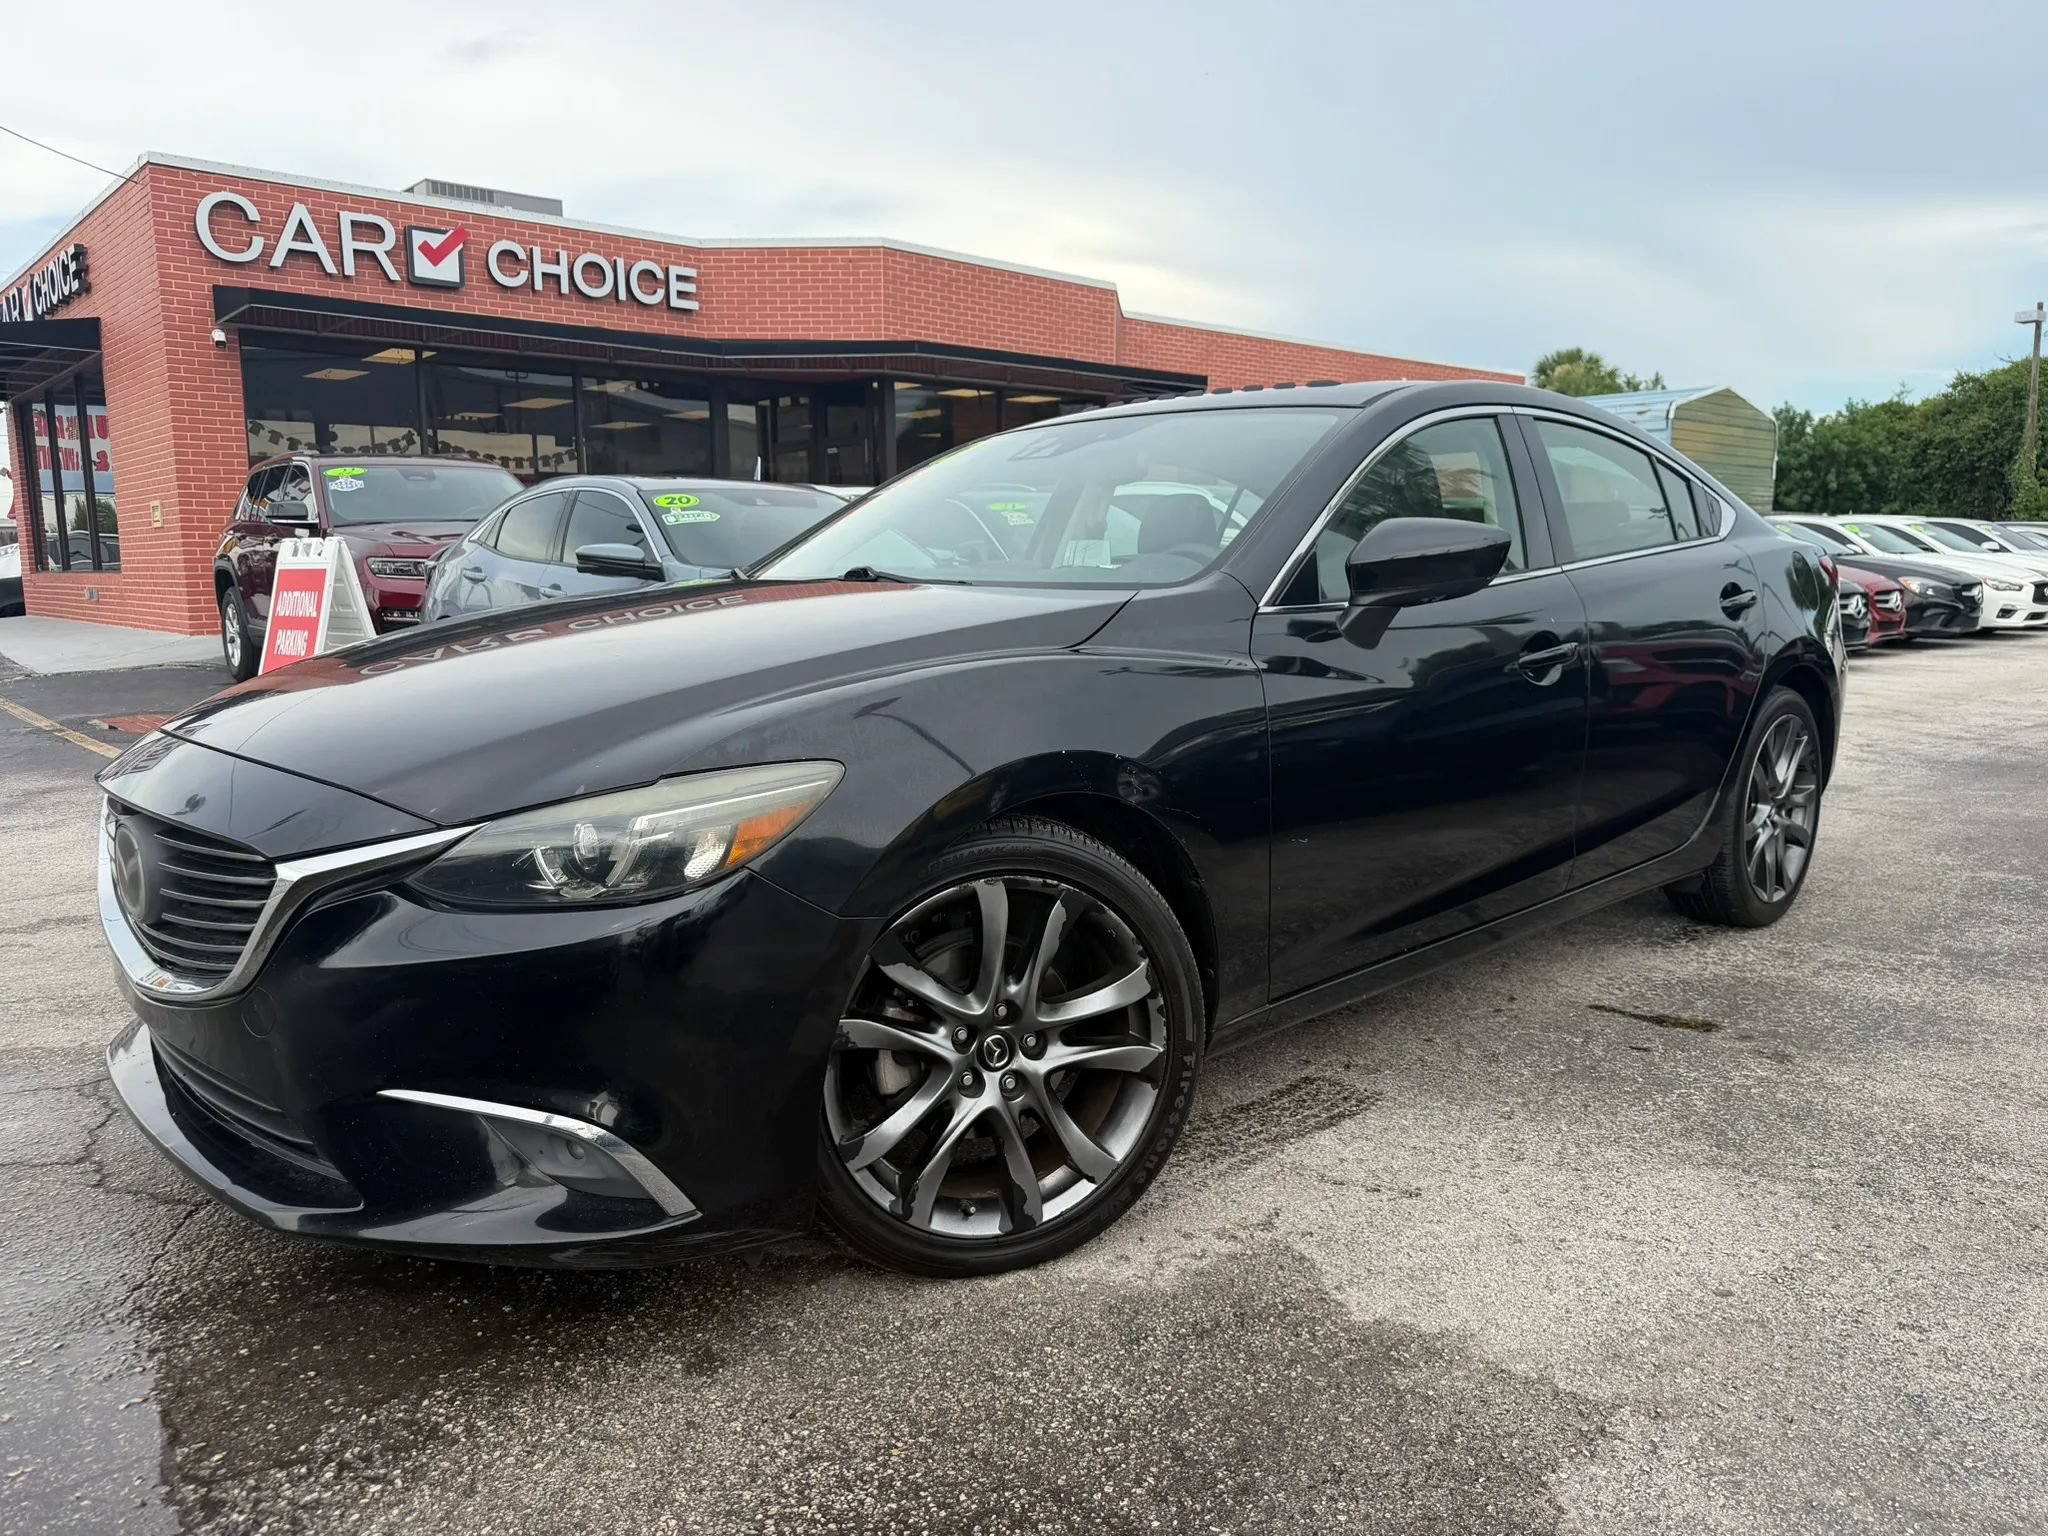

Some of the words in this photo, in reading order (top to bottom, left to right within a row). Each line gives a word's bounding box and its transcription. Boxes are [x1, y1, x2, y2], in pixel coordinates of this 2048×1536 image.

[195, 191, 402, 282] CAR
[487, 240, 700, 311] CHOICE
[0, 287, 20, 322] AR
[33, 244, 80, 315] CHOICE
[664, 495, 692, 505] 20
[276, 591, 316, 617] ADDITIONAL
[274, 630, 307, 656] PARKING
[1134, 1052, 1196, 1184] Firestone
